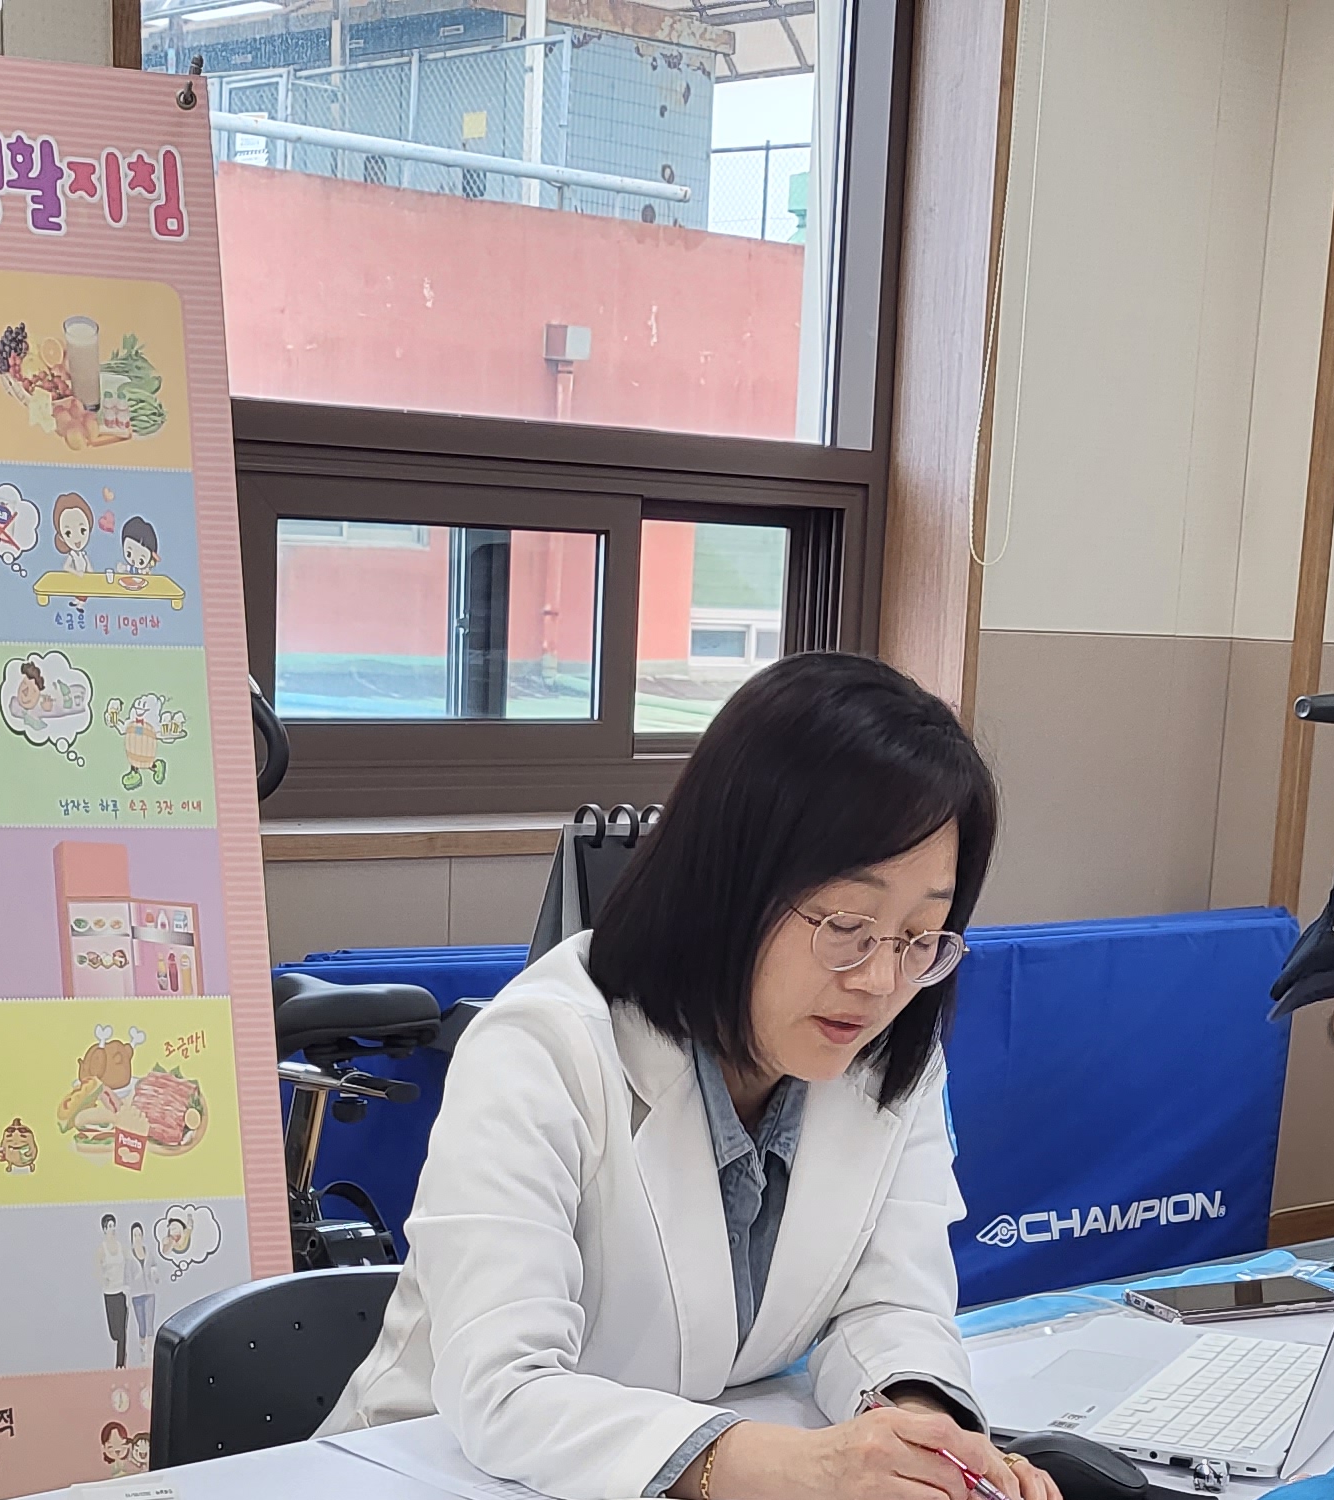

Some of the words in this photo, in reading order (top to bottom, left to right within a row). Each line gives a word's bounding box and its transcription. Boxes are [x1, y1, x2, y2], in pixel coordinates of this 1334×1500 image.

[54, 611, 87, 631] 소금은
[59, 799, 91, 816] 남자는
[98, 799, 120, 820] 하루
[128, 799, 148, 820] 소주
[181, 799, 202, 813] 이내
